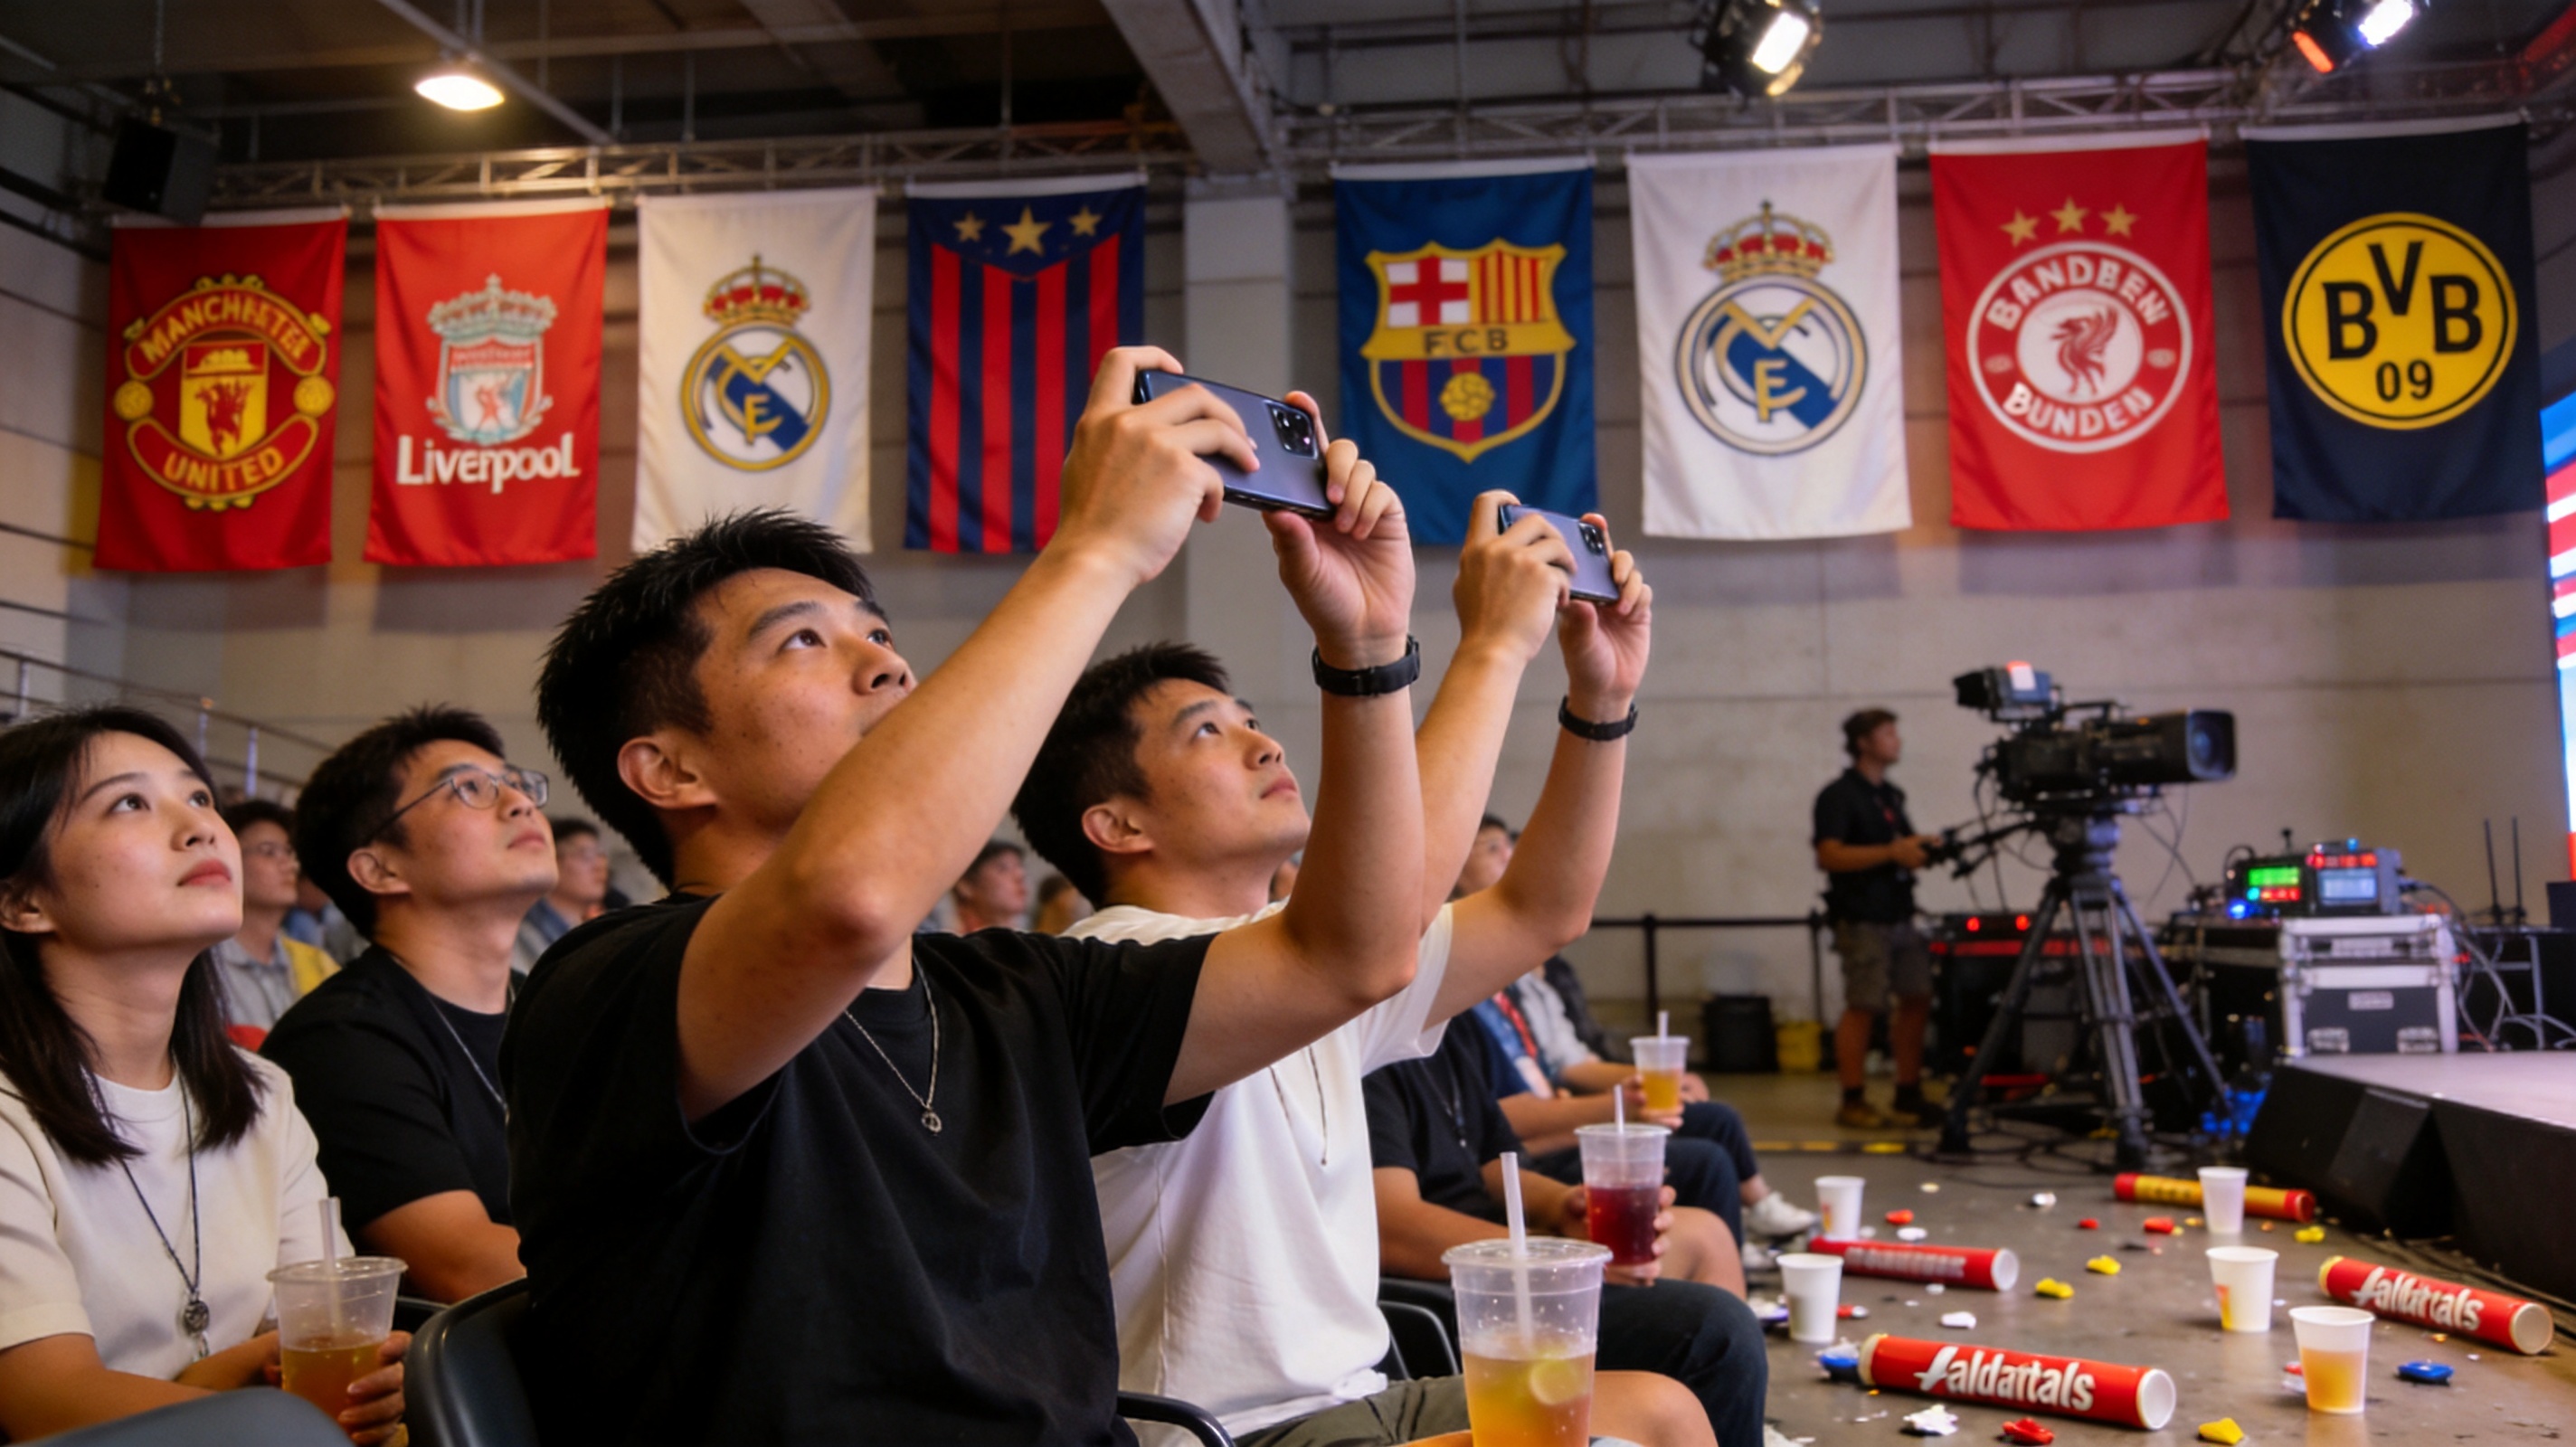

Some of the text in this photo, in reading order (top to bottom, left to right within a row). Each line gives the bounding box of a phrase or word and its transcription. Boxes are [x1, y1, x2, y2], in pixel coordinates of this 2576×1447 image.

[2322, 240, 2483, 361] BVB
[1423, 328, 1509, 355] FCB
[2376, 359, 2433, 402] 09
[163, 447, 284, 492] UNITED
[396, 431, 582, 495] Liverpool
